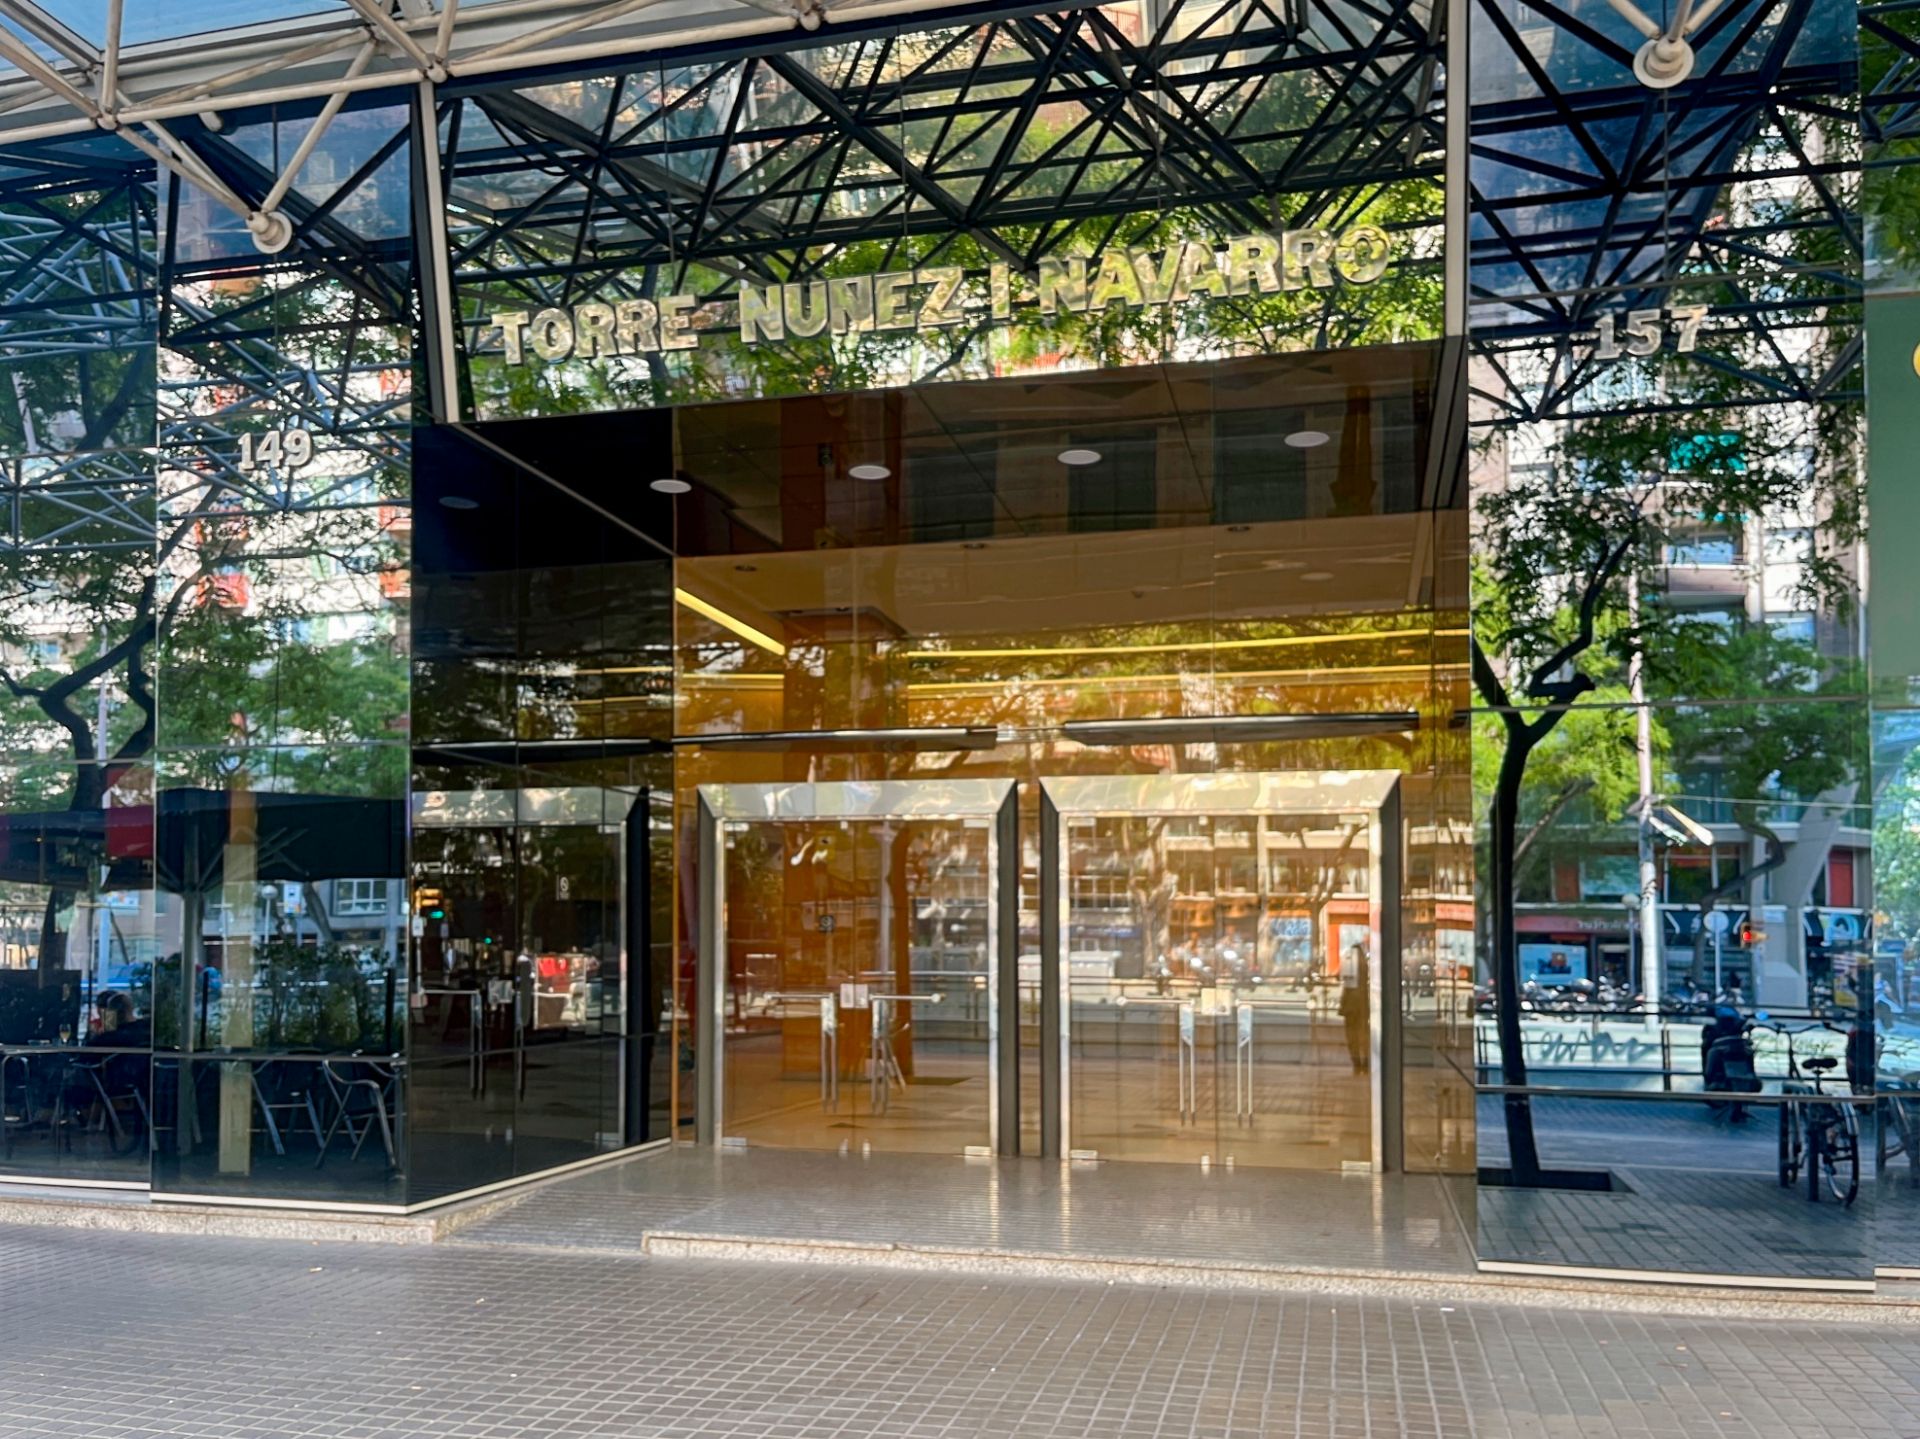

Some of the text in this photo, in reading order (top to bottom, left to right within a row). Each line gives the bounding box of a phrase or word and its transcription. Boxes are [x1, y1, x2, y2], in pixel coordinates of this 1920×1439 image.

[492, 224, 1391, 366] TORRE NUNEZ I NAVARRO
[1594, 304, 1708, 359] 157
[238, 429, 312, 471] 149
